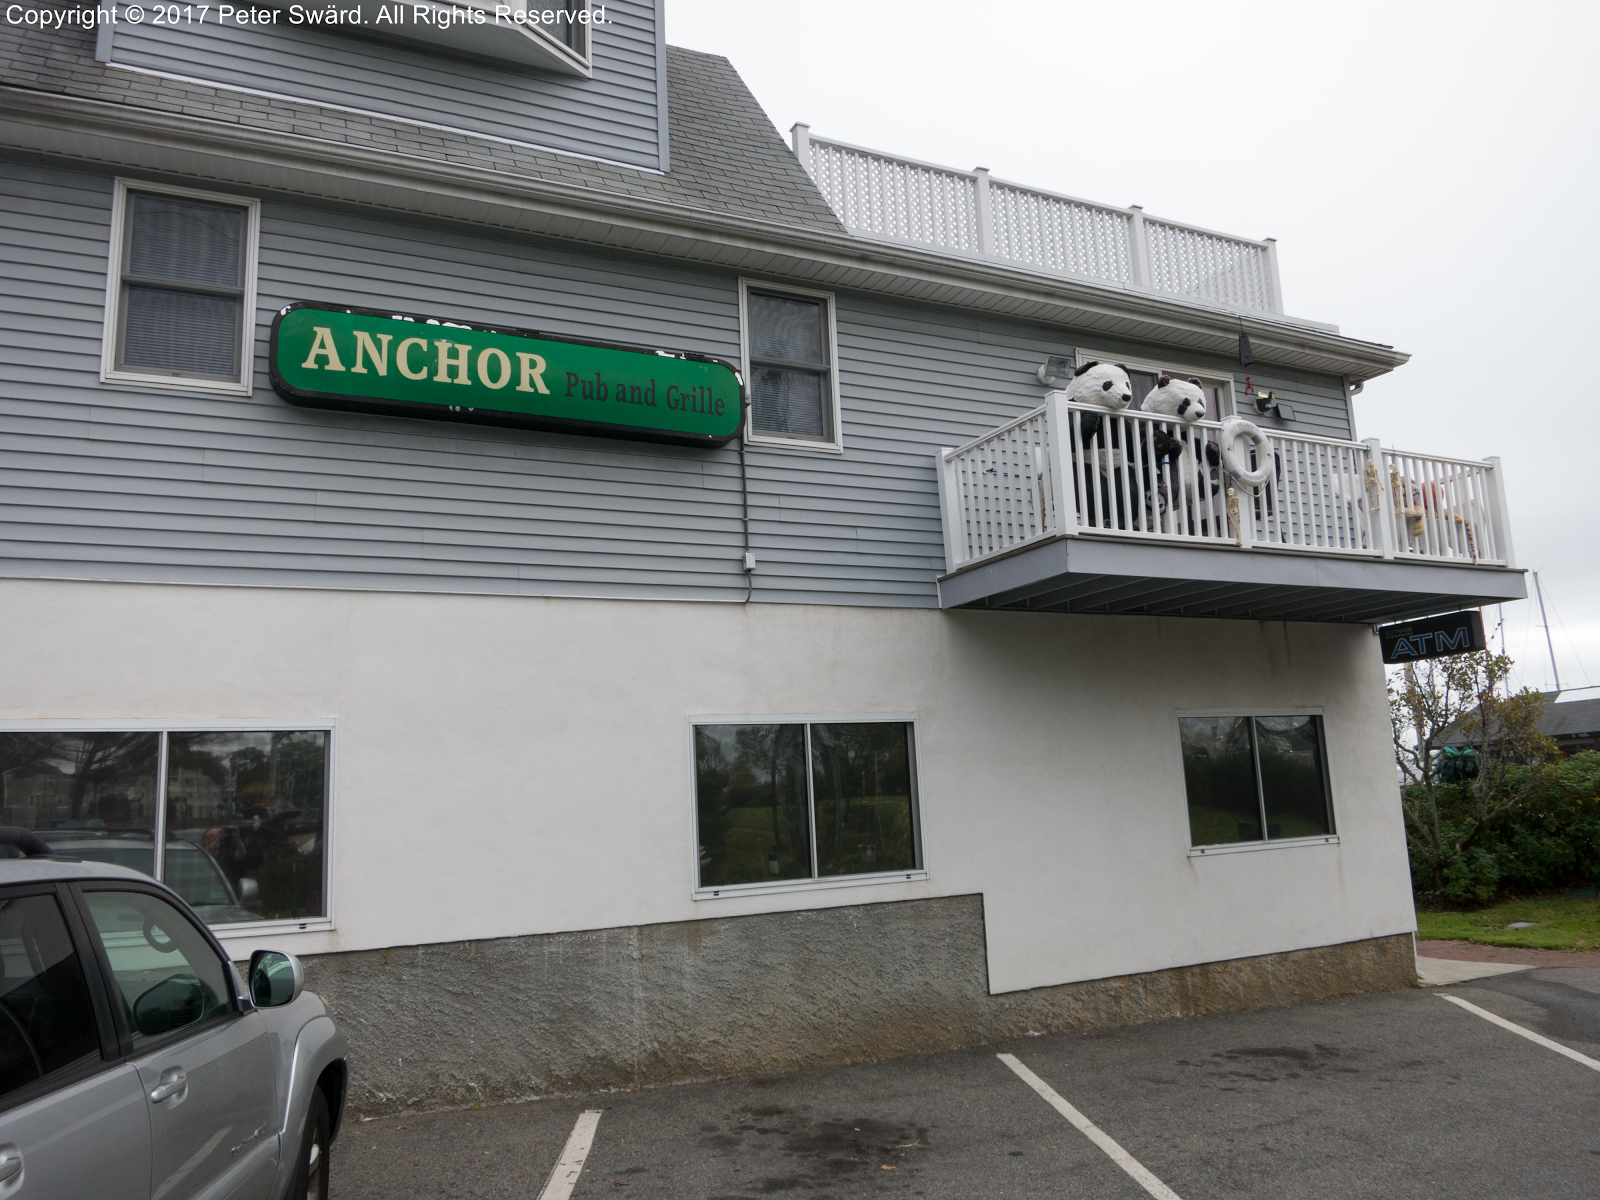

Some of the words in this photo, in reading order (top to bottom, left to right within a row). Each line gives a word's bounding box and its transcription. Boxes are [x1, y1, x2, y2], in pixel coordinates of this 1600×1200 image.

[301, 326, 550, 395] ANCHOR
[565, 371, 609, 402] Pub
[615, 378, 657, 407] and
[666, 385, 725, 417] Grille
[1390, 627, 1470, 659] ATM
